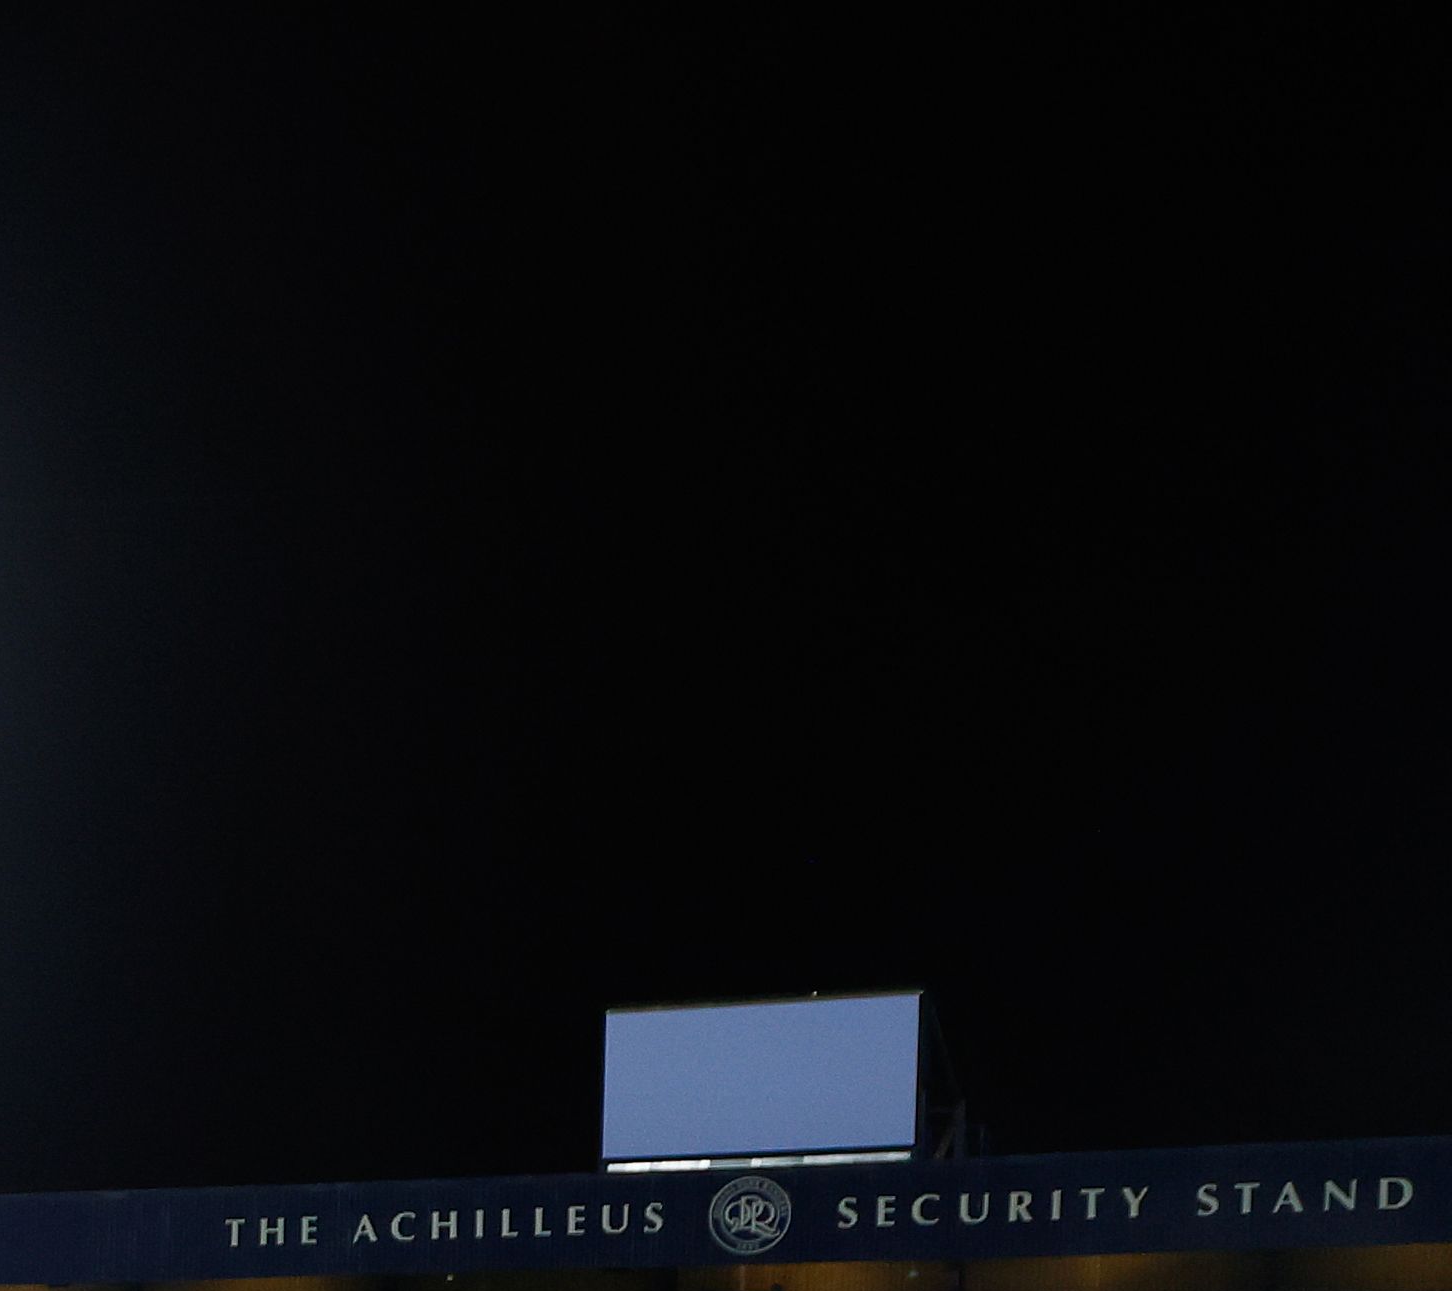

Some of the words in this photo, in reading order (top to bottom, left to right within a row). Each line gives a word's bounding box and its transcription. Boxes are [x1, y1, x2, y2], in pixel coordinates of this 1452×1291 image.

[225, 1215, 318, 1247] THE
[352, 1202, 664, 1243] ACHILLEUS
[837, 1186, 1148, 1229] SECURITY
[1196, 1177, 1414, 1217] STAND
